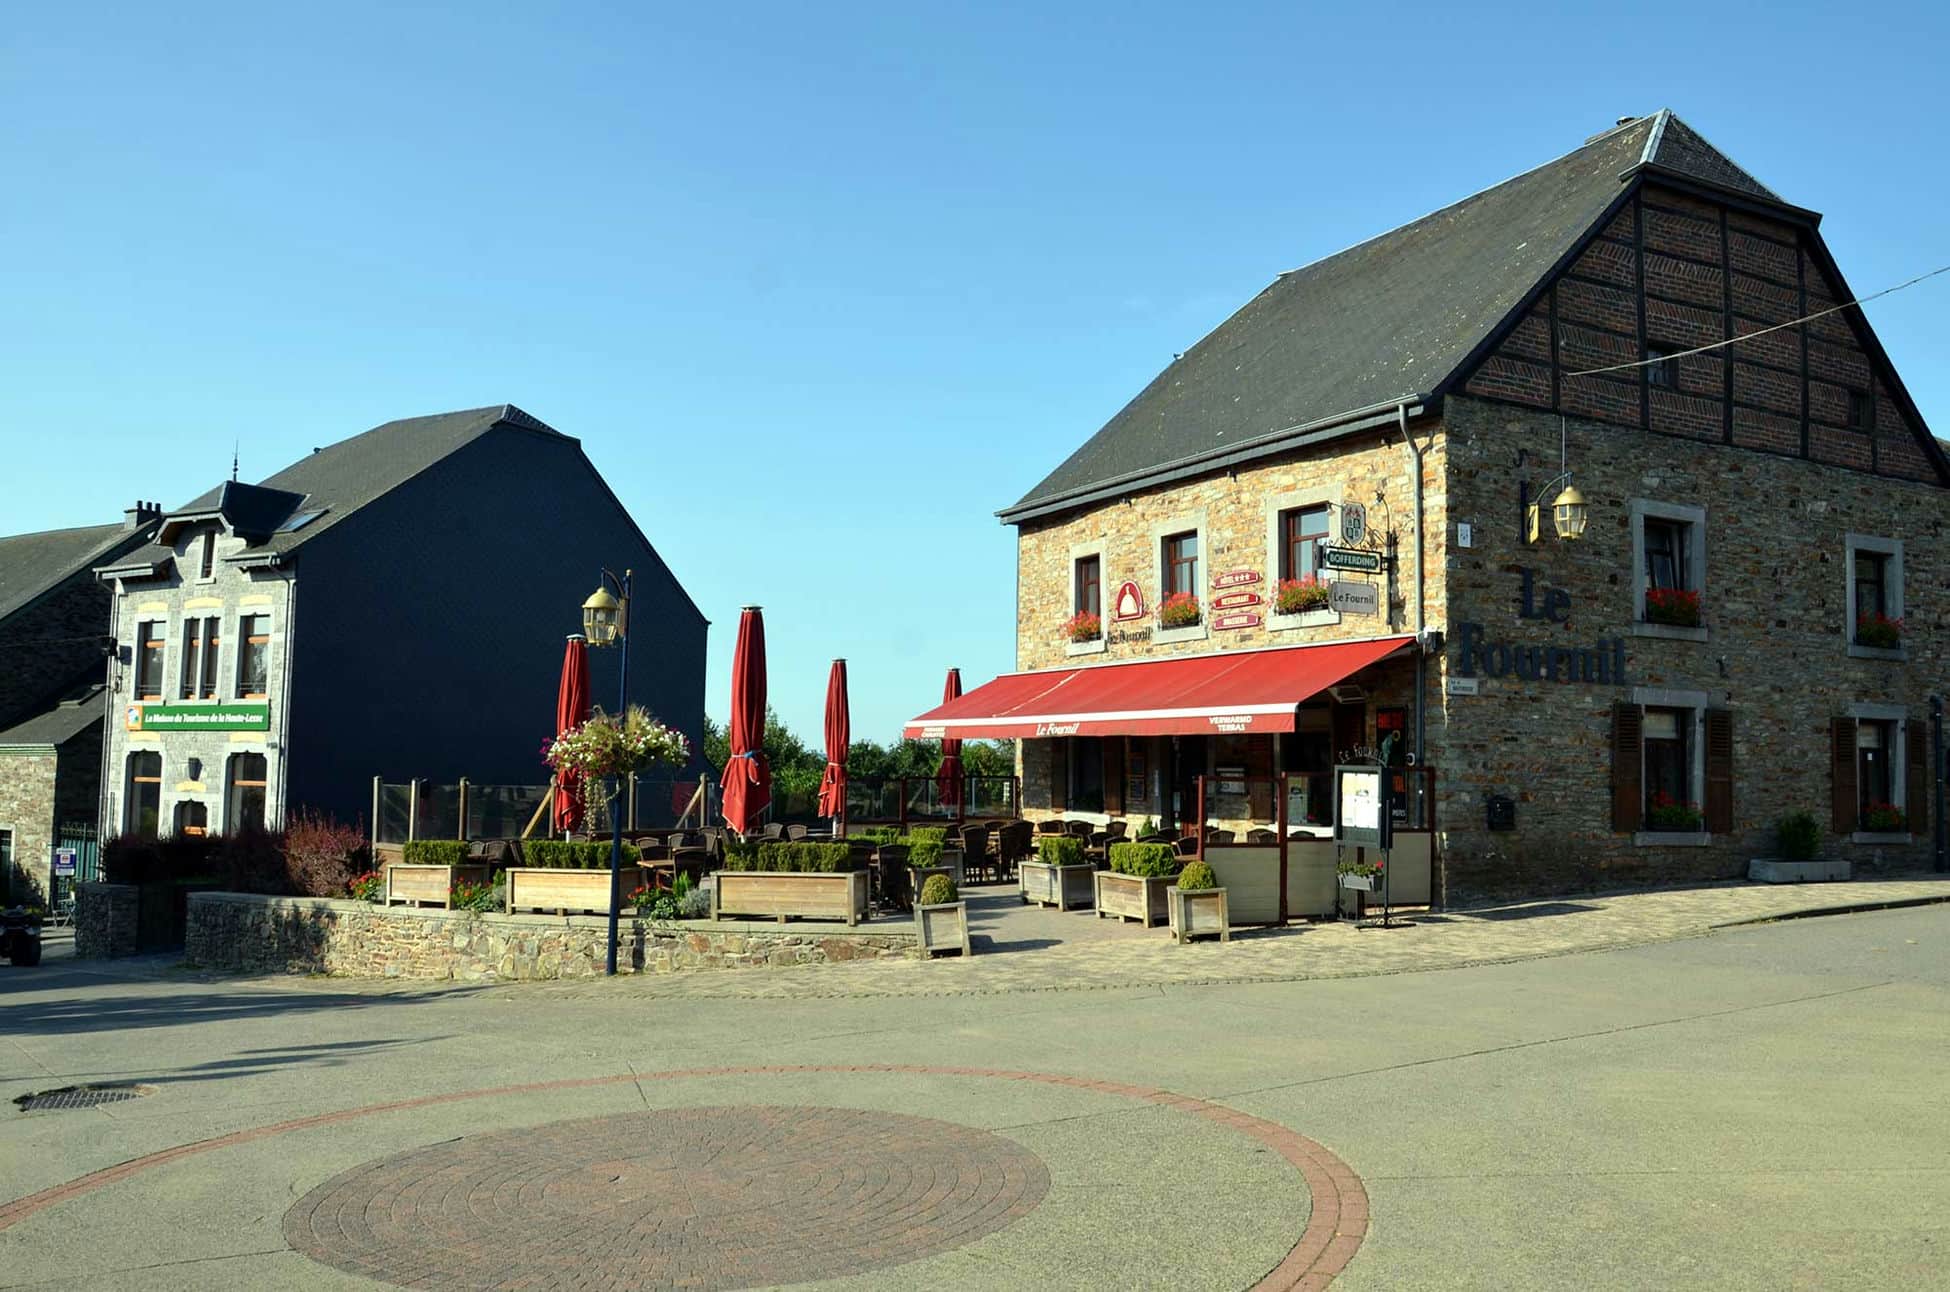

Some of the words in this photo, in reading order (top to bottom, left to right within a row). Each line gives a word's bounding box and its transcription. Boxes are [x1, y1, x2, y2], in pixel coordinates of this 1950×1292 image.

[1329, 553, 1376, 568] BOFFERDING
[1333, 592, 1344, 602] Le
[1345, 592, 1374, 605] Fournil
[1519, 566, 1571, 622] Le
[1457, 621, 1625, 685] Fournil
[1036, 723, 1047, 736] Le
[1047, 722, 1080, 735] Fournil
